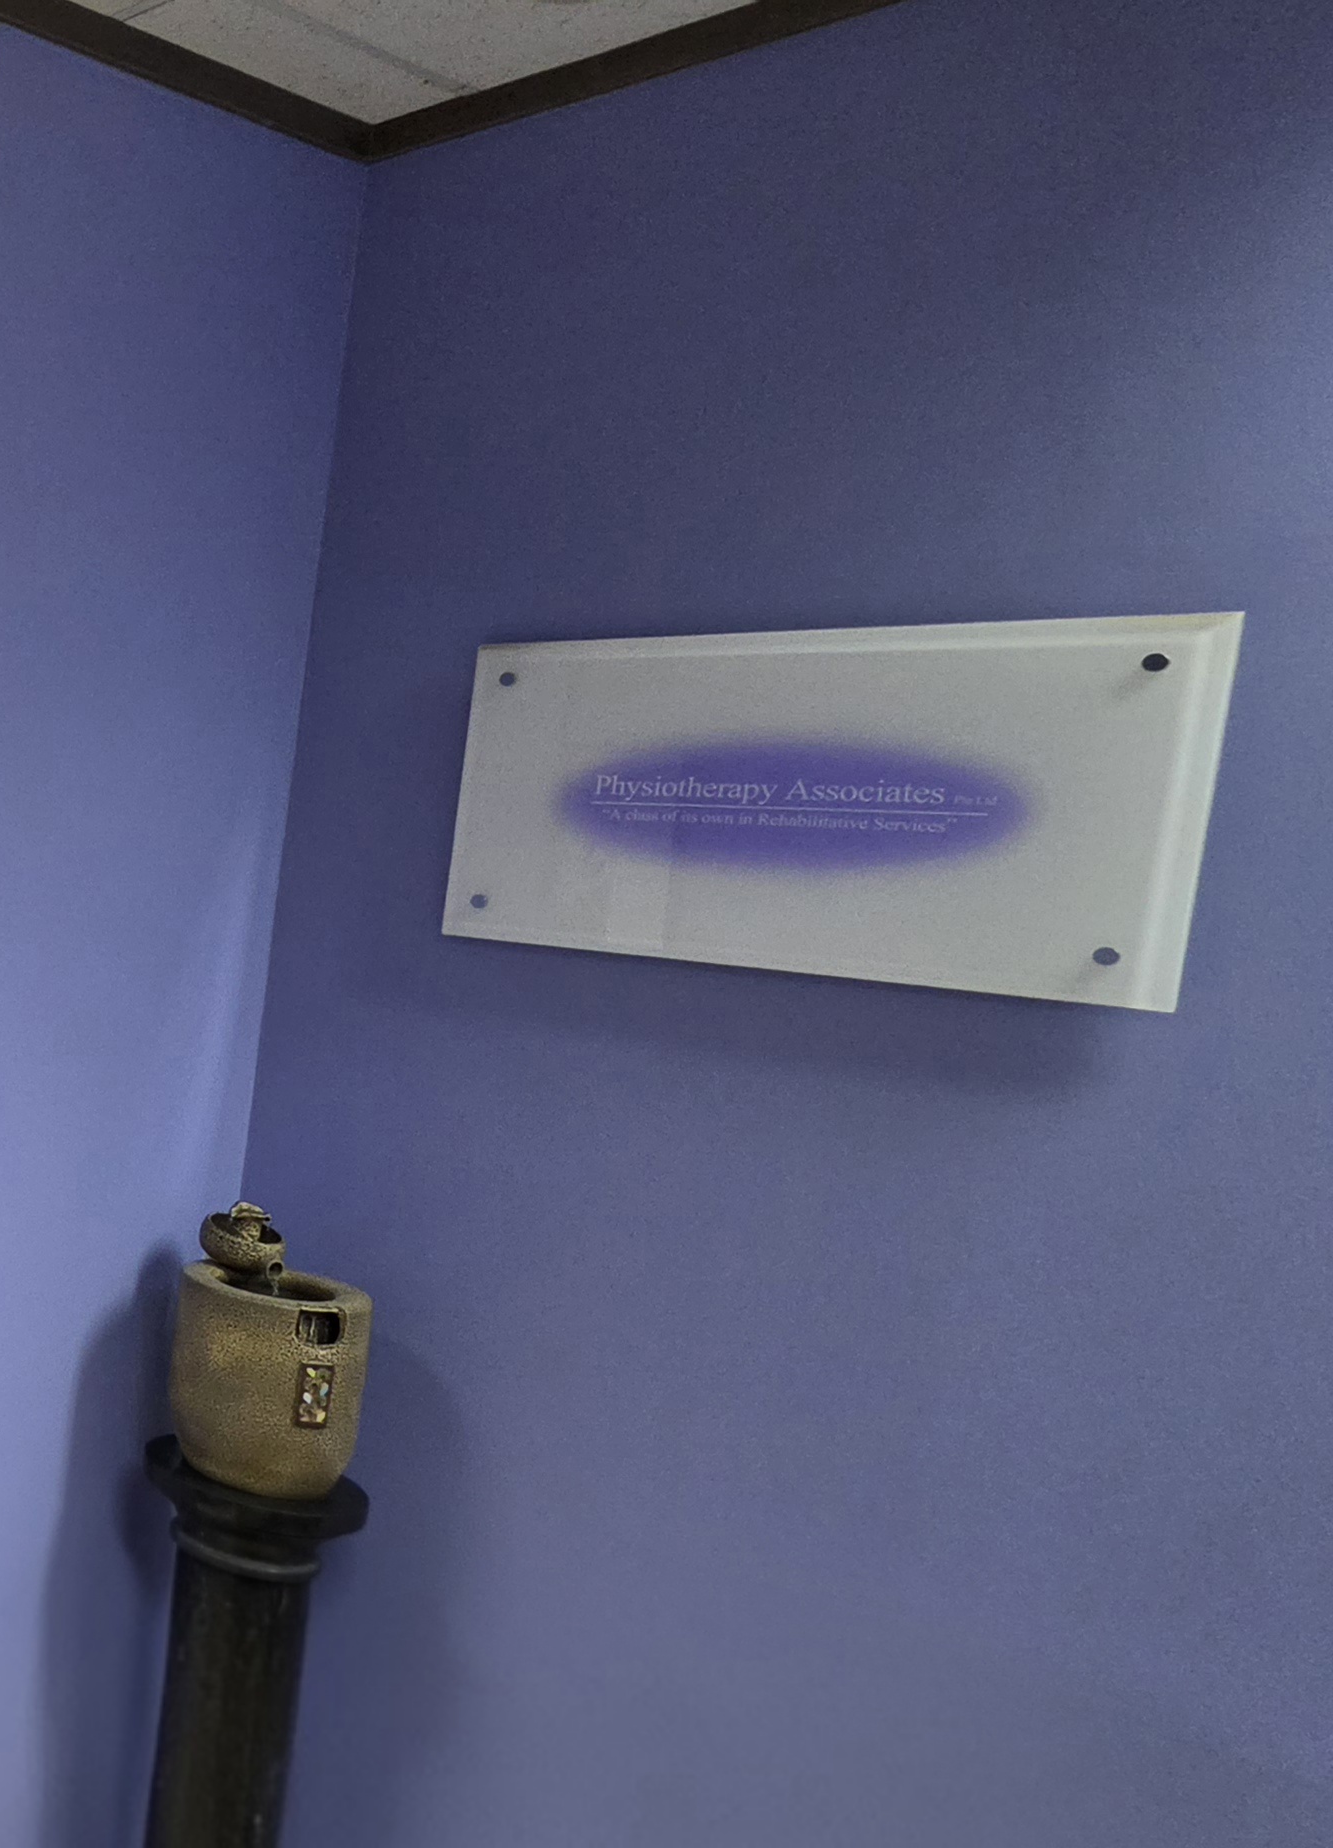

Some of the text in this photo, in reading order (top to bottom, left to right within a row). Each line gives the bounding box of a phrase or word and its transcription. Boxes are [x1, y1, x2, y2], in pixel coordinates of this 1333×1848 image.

[594, 774, 779, 805] Physiotherapy
[785, 778, 945, 804] Associates
[662, 810, 678, 822] of
[702, 813, 734, 824] own
[739, 812, 752, 825] in
[757, 812, 867, 830] Rehabilitative
